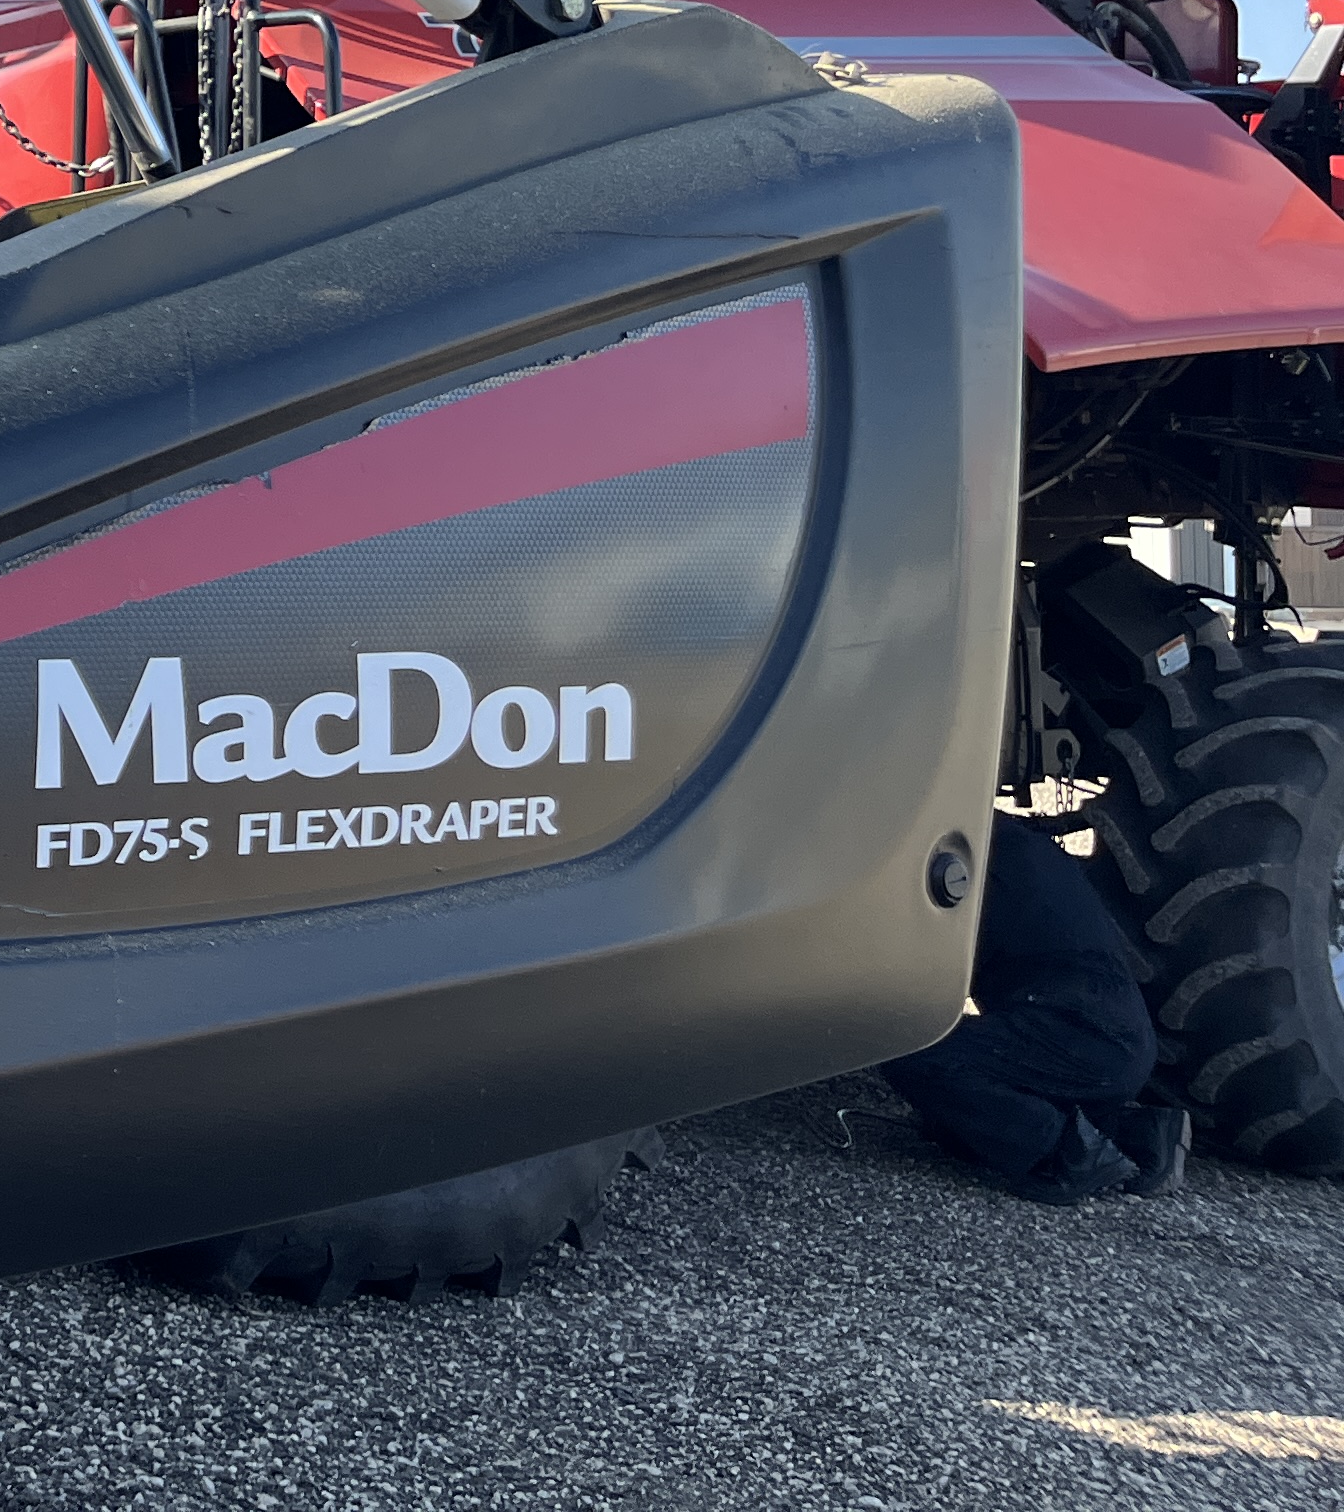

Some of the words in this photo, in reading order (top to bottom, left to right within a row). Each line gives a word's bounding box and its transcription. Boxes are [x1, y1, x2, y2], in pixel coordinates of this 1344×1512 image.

[34, 651, 634, 790] MacDon
[36, 817, 209, 869] FD75-S
[237, 796, 558, 856] FLEXDRAPER
